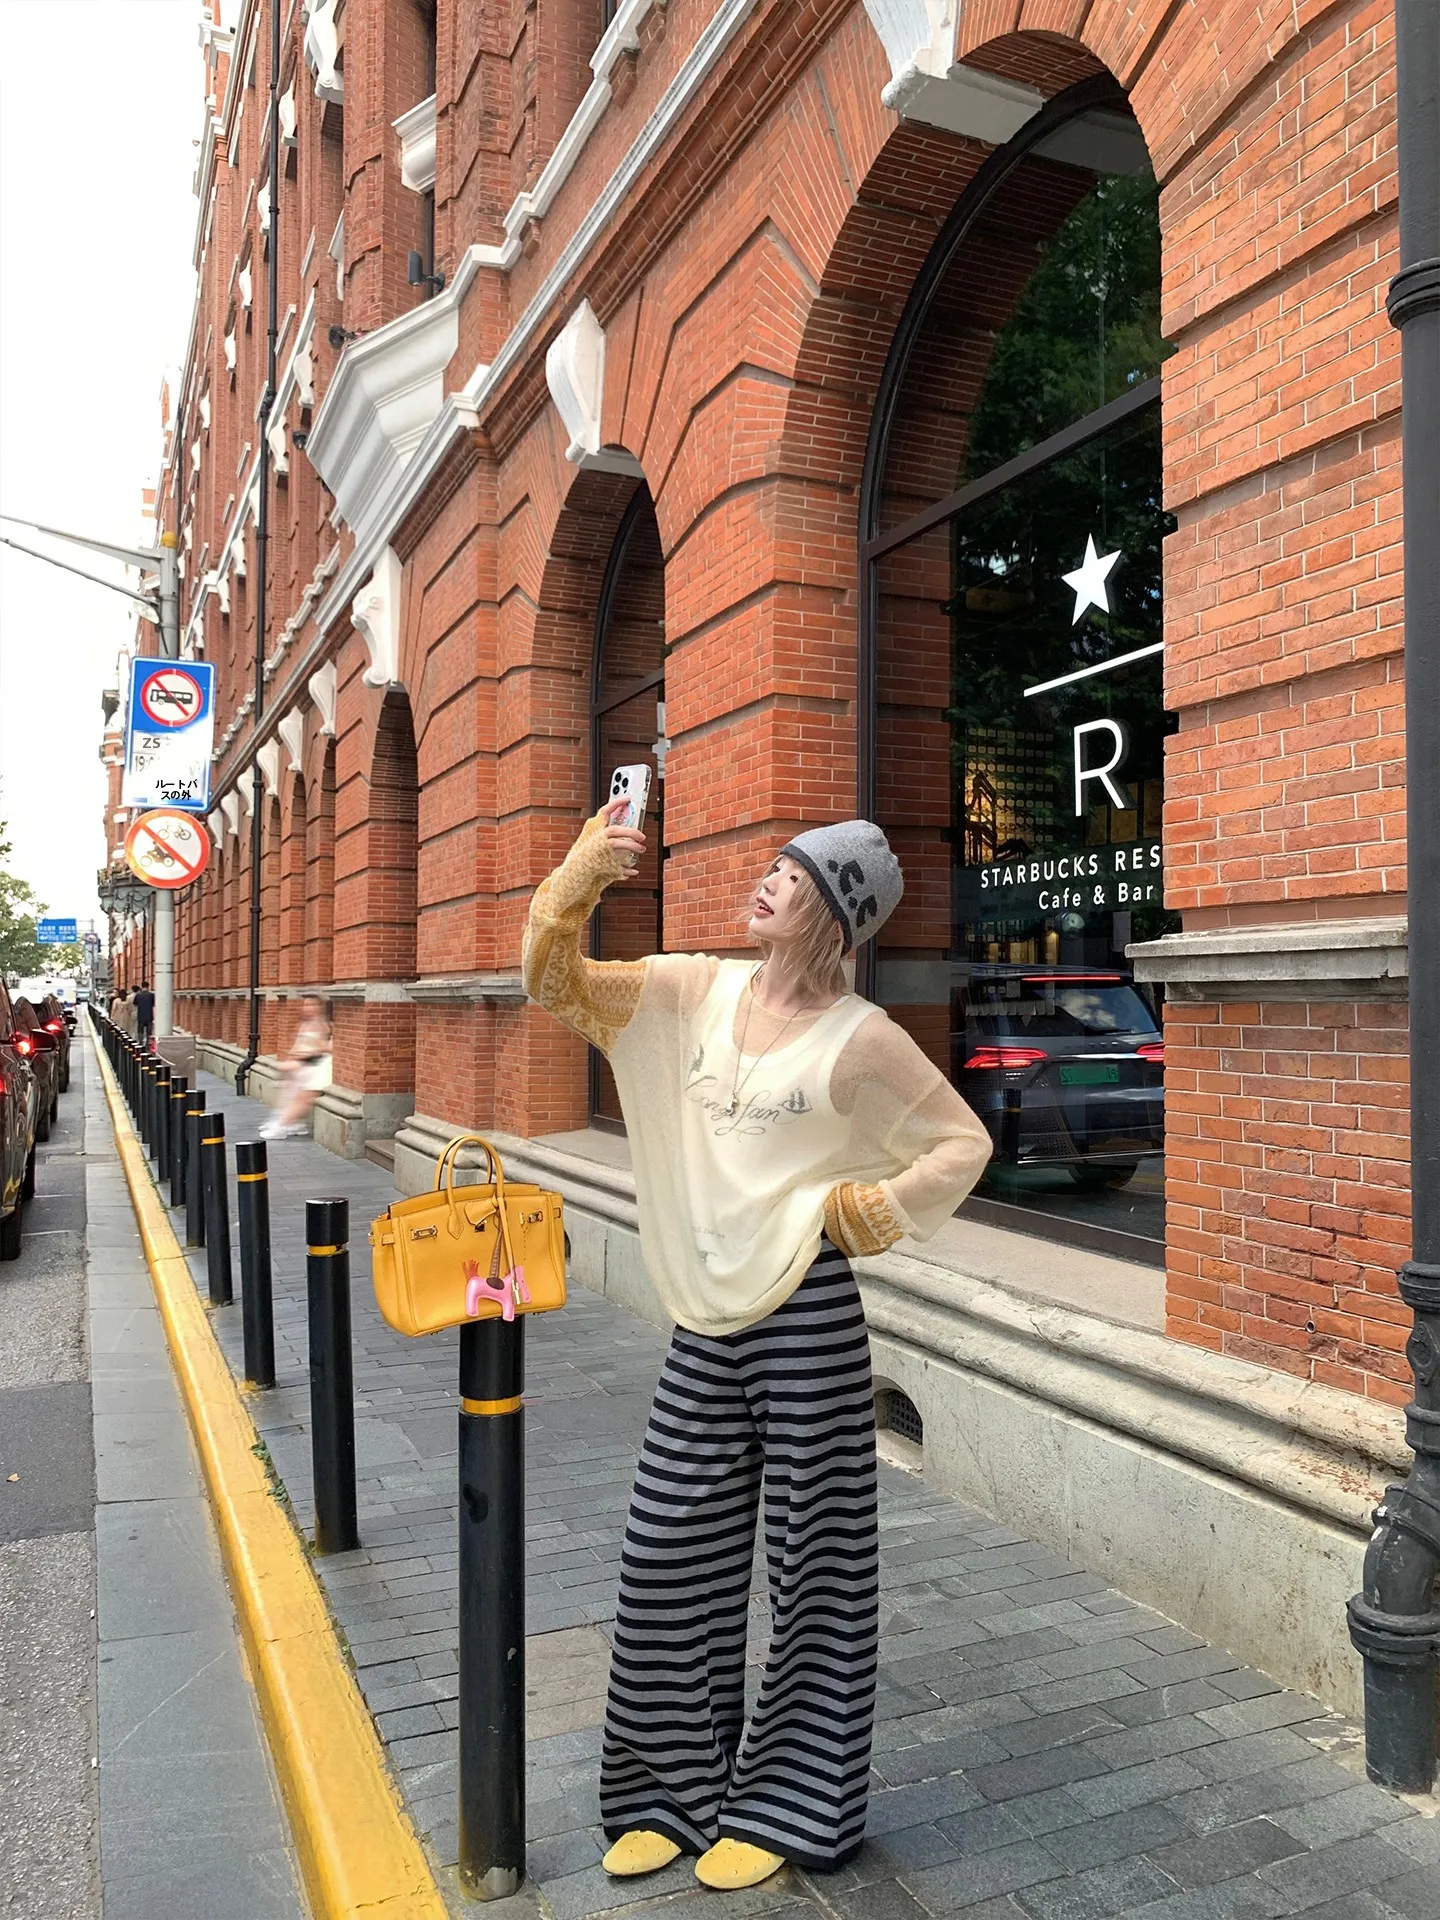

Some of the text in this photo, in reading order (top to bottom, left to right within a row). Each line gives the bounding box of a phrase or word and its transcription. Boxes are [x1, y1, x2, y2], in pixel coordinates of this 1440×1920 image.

[1073, 718, 1125, 817] R
[155, 779, 198, 789] ルートバ
[161, 789, 192, 801] スの外
[981, 845, 1161, 889] STARBUCKS RES
[1039, 882, 1154, 910] Cafe & Bar
